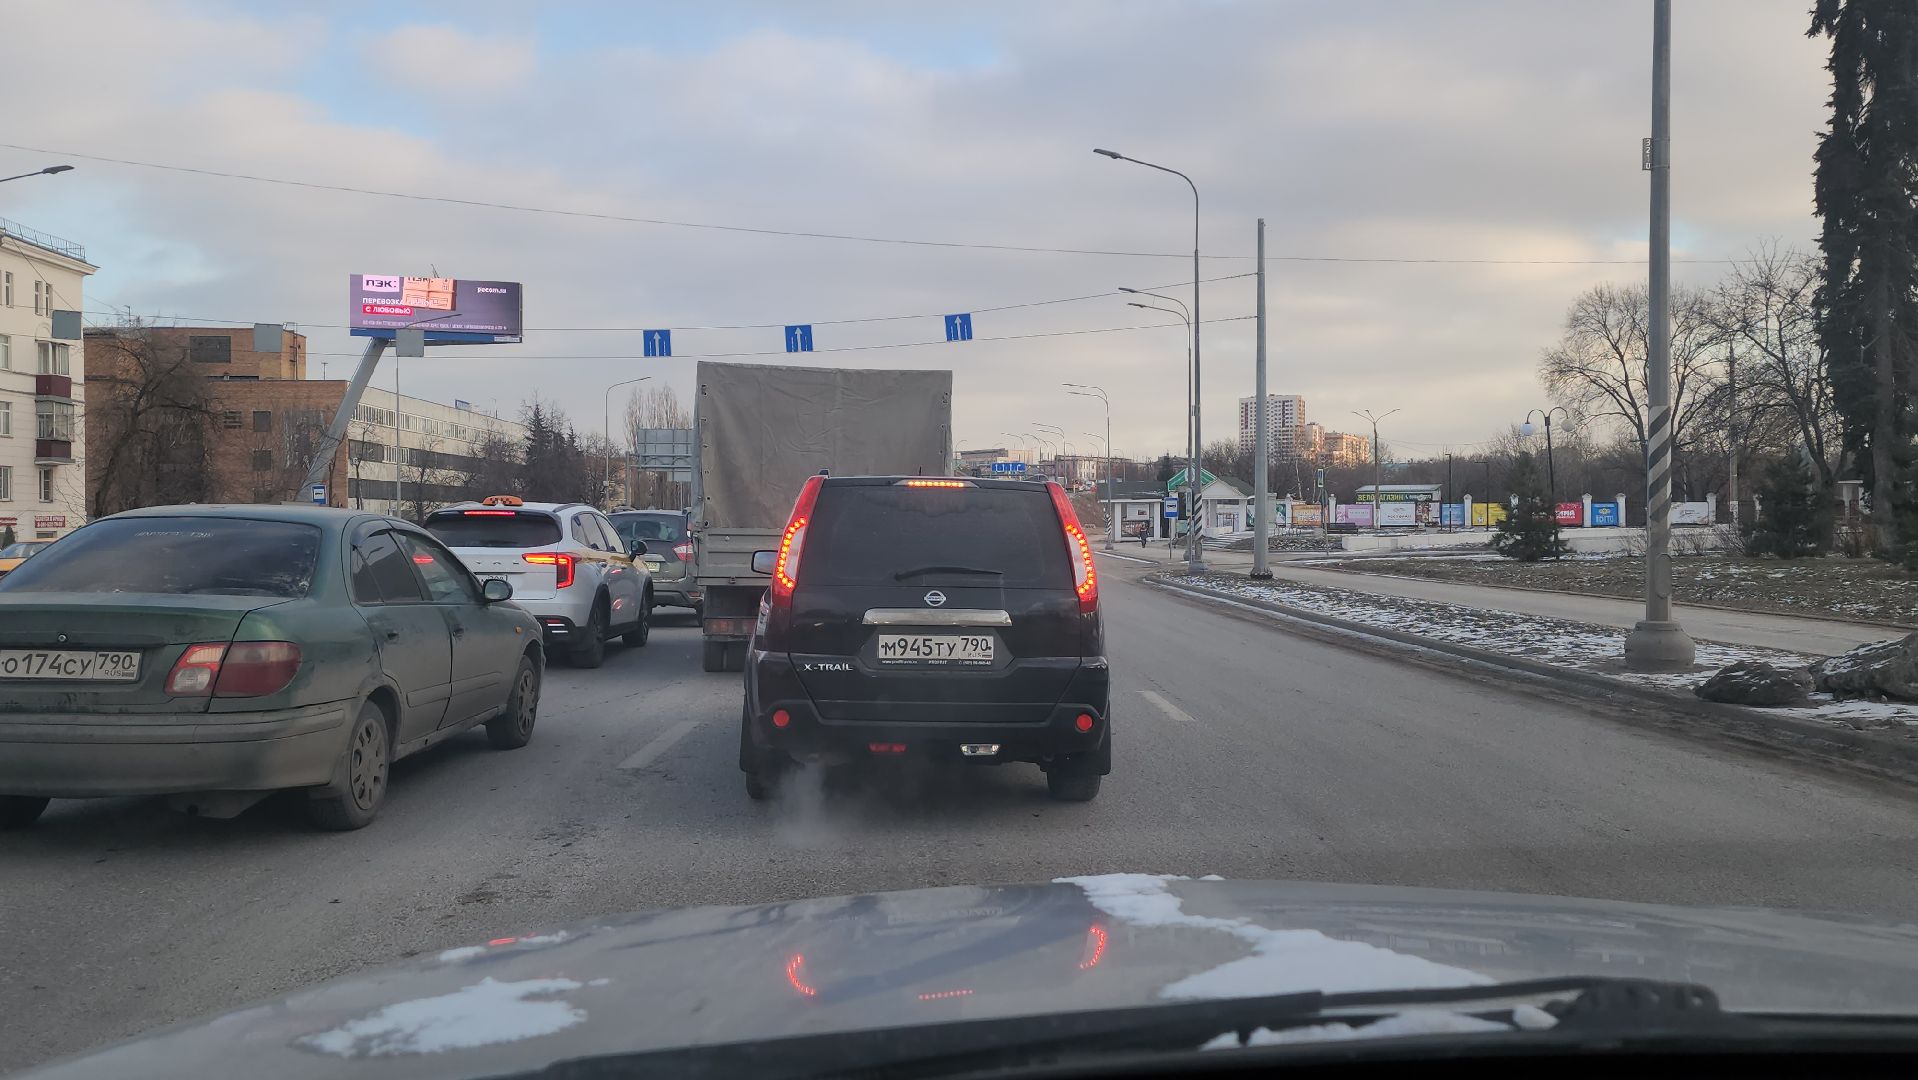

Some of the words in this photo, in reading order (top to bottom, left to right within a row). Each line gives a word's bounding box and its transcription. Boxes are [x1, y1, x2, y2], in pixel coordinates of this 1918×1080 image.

[373, 306, 411, 315] ЛЮБОВЬЮ
[1357, 493, 1404, 501] ВЕЛОАГАЗИН
[961, 637, 989, 652] 790
[98, 653, 133, 670] 790
[803, 662, 854, 671] X-TRAIL
[104, 669, 122, 677] RUS
